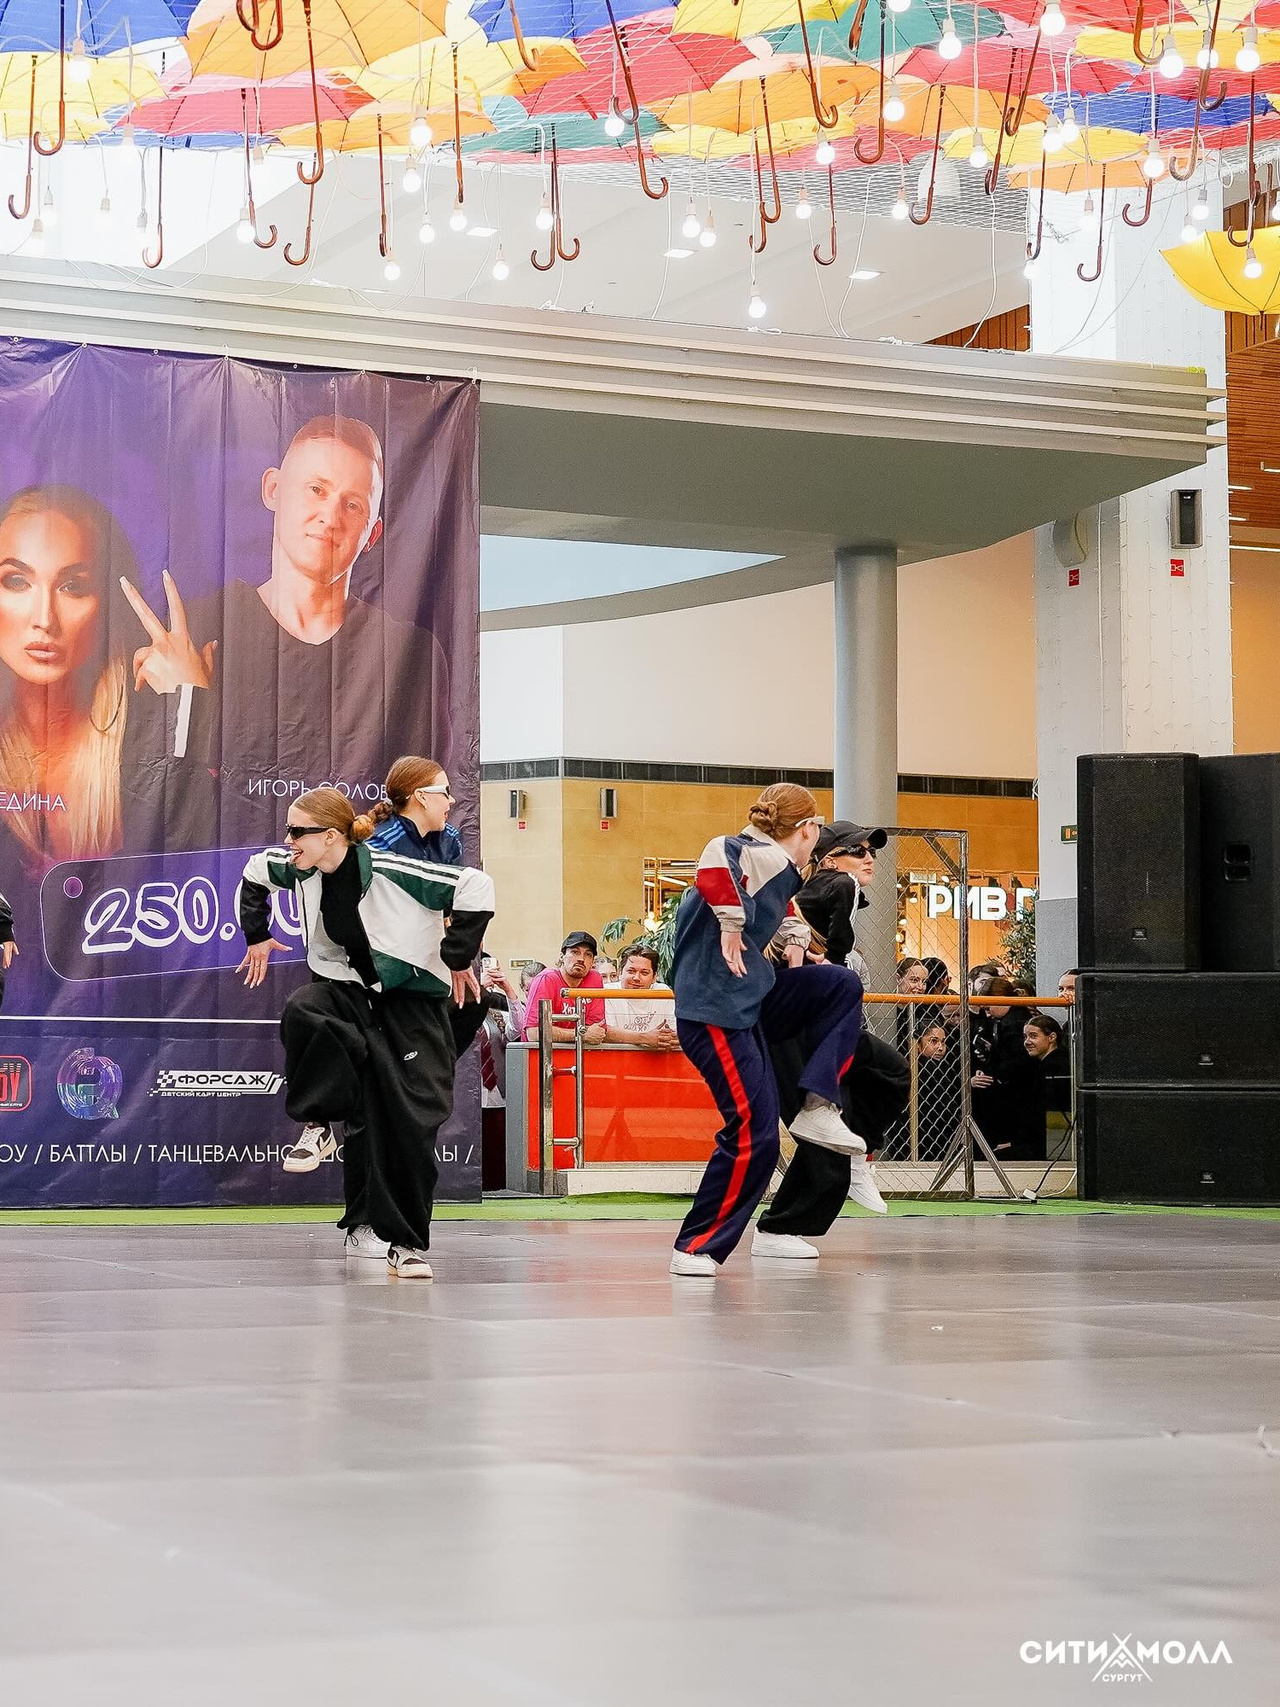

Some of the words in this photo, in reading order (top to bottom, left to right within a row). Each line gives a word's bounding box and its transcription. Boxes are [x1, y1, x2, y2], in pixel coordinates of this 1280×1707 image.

[928, 884, 1008, 921] РИВ
[177, 1074, 268, 1086] ФОРСАЖ
[160, 1090, 195, 1098] ДЕТСКИЙ
[49, 1144, 127, 1164] БАТТЛЫ
